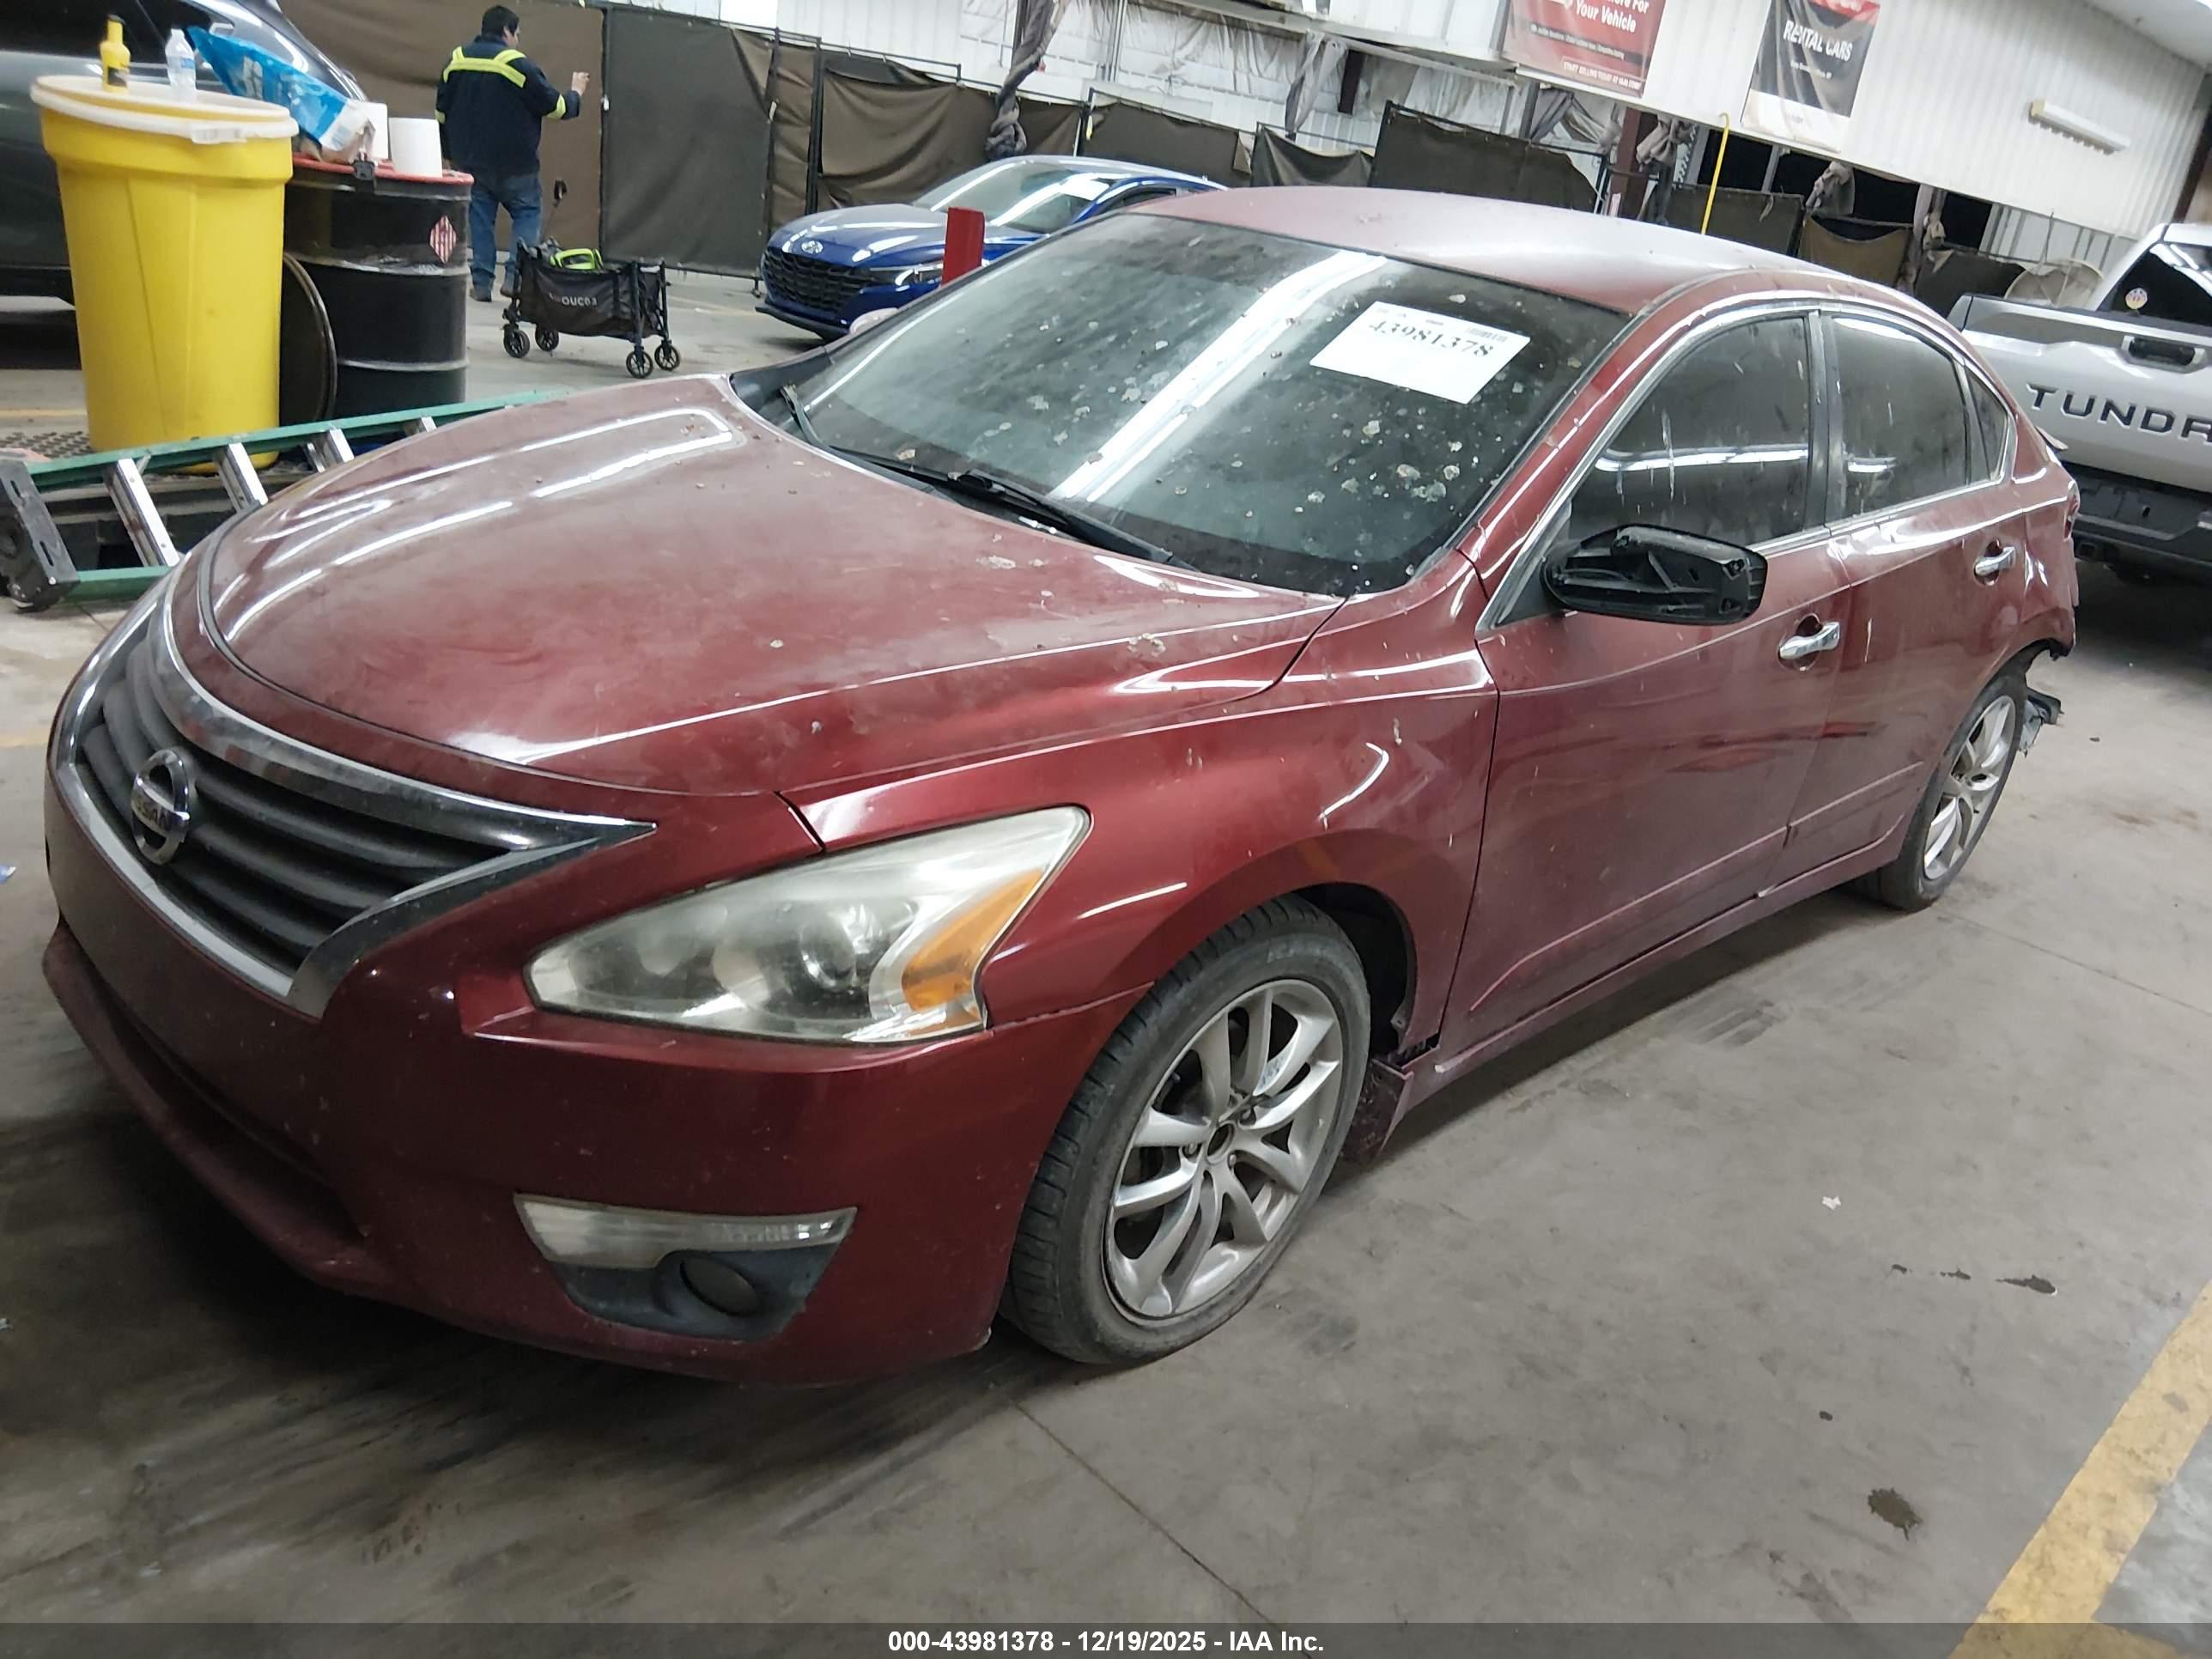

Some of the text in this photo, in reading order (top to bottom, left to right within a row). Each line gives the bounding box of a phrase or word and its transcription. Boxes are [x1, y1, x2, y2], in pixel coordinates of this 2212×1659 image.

[1576, 0, 1637, 33] Your Vehicle
[1784, 19, 1853, 62] RENTAL CARS
[1370, 320, 1494, 357] 43981378
